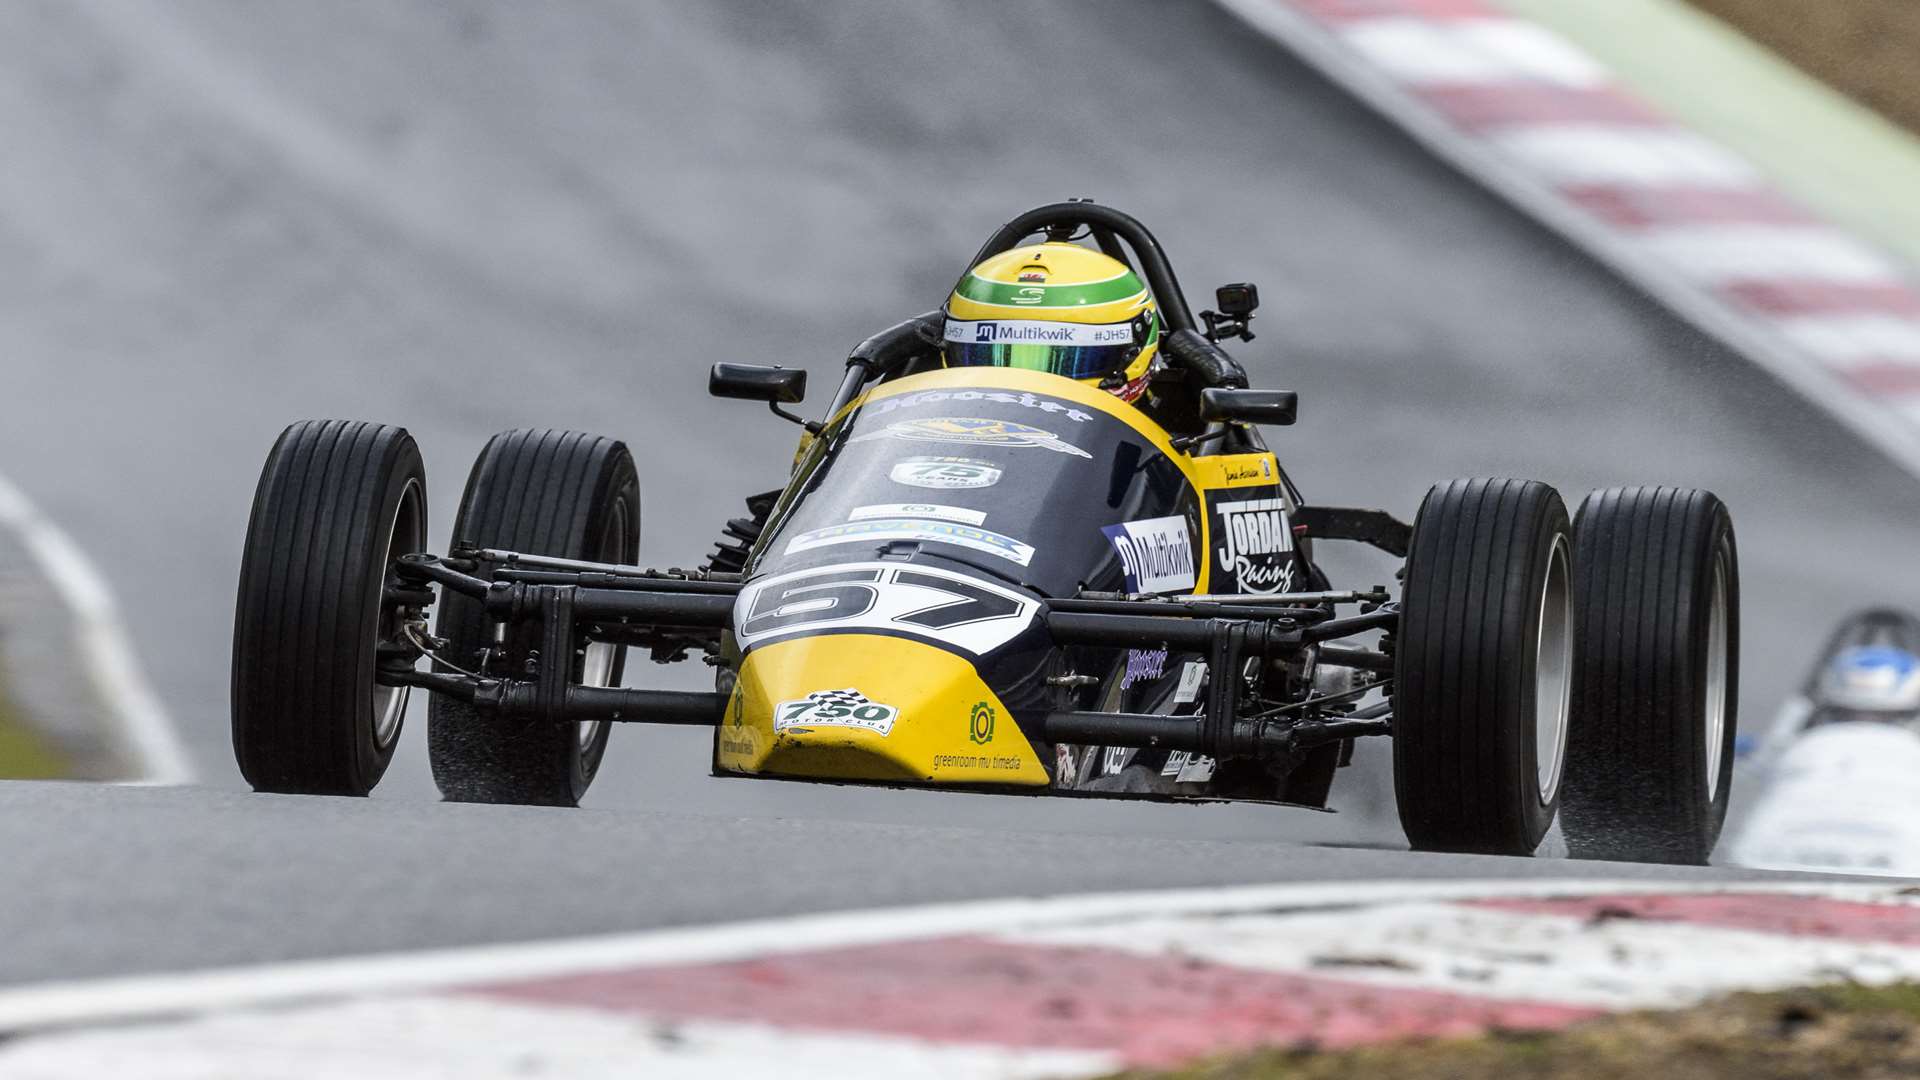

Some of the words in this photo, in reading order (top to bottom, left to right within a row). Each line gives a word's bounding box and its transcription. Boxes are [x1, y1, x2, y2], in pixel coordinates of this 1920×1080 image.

[999, 327, 1074, 340] Multikwik
[1094, 329, 1130, 341] #JH57
[911, 464, 985, 478] 75
[1136, 529, 1192, 579] Multikwik
[1235, 556, 1295, 594] Racing
[741, 568, 1026, 637] 57
[783, 700, 891, 721] 750
[845, 720, 885, 730] CLUB
[933, 754, 977, 771] greenroom
